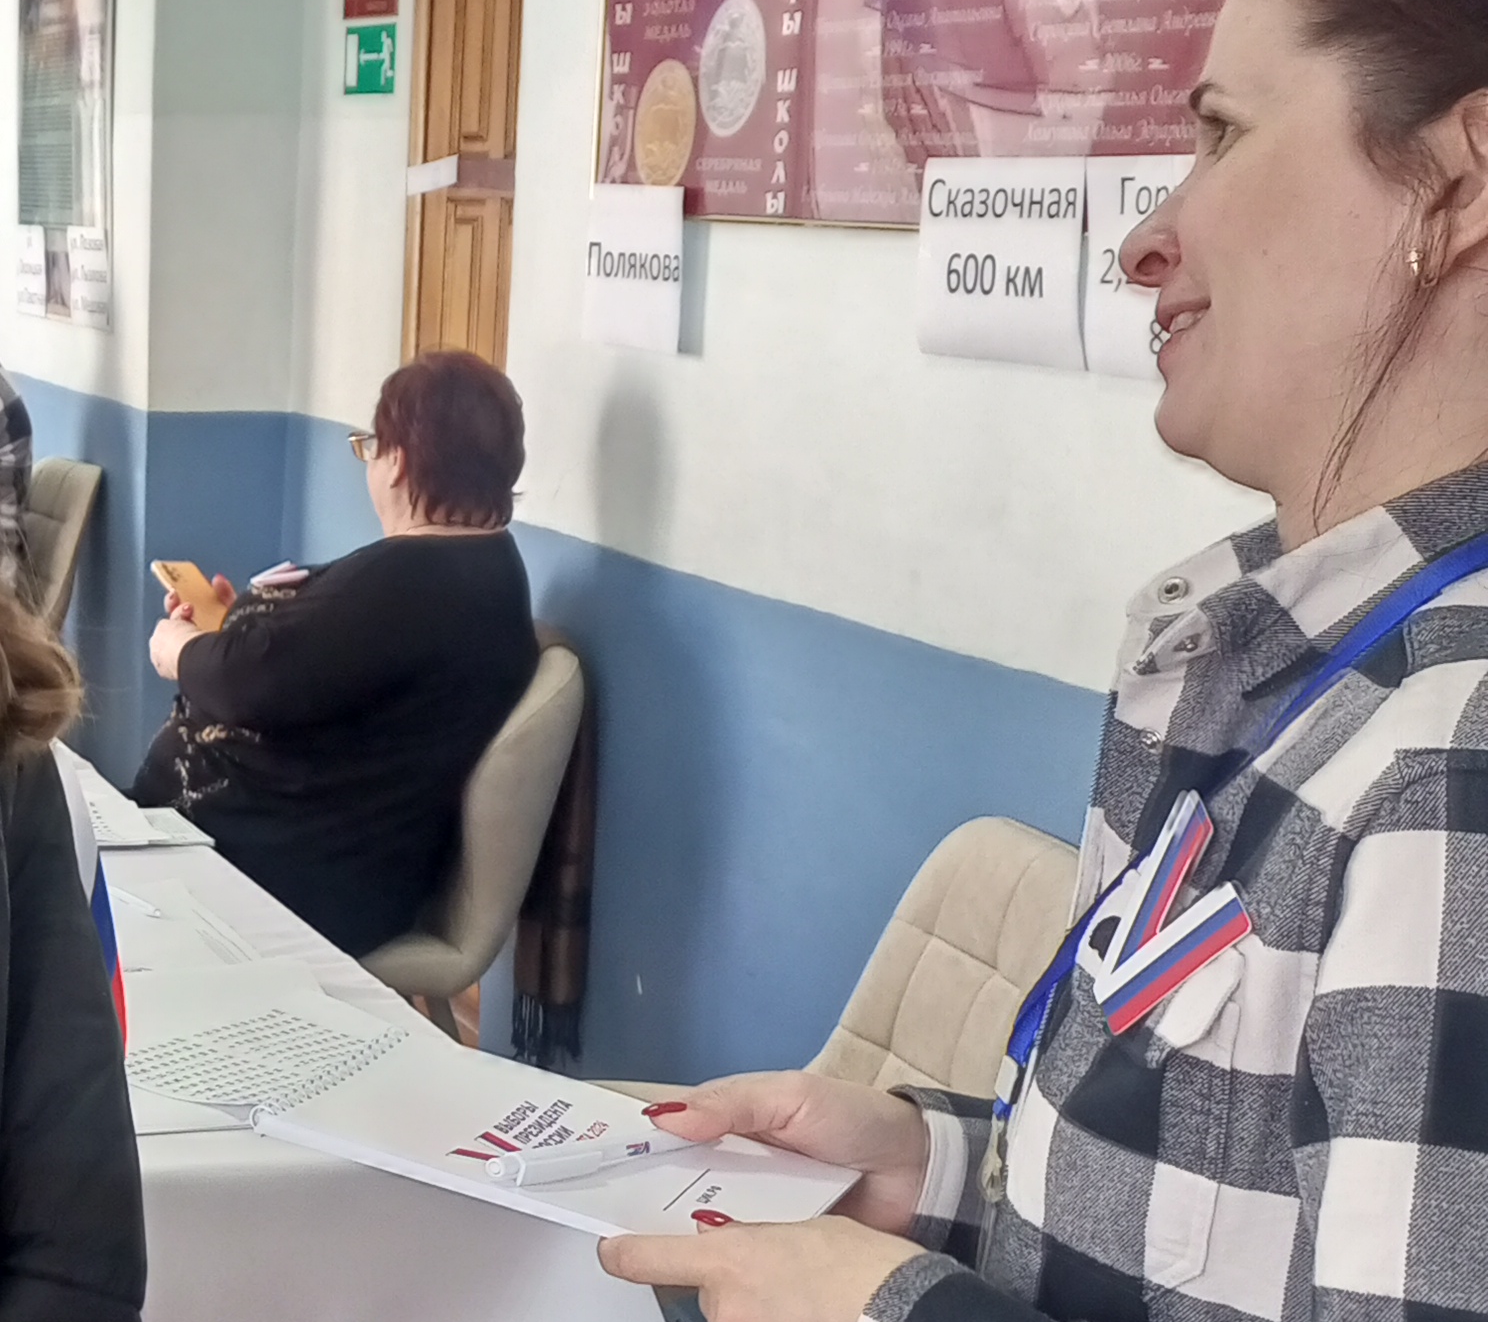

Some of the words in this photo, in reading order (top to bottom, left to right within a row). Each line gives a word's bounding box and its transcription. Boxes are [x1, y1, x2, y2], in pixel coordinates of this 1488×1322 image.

[765, 68, 798, 215] ШКОЛЫ
[927, 178, 1078, 219] Сказочная
[587, 241, 680, 282] Полякова
[946, 253, 997, 296] 600
[1005, 265, 1044, 299] км
[493, 1100, 539, 1135] ВЫБОРЫ
[512, 1099, 574, 1145] ПРЕЗИДЕНТА
